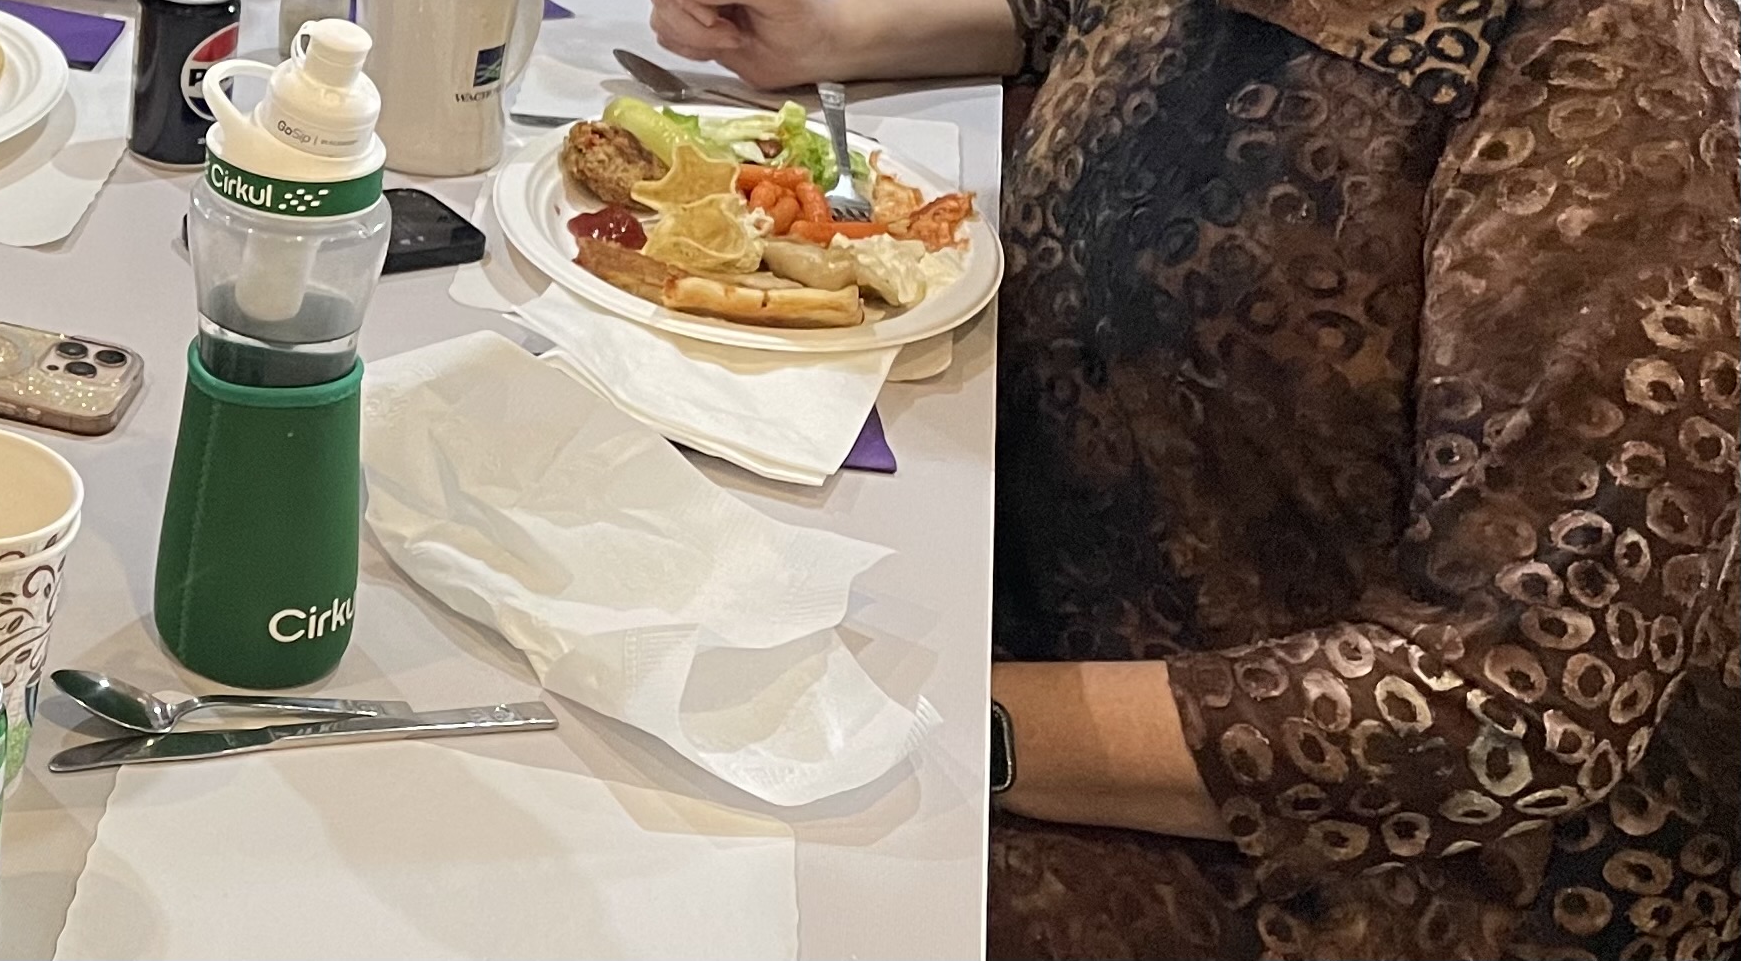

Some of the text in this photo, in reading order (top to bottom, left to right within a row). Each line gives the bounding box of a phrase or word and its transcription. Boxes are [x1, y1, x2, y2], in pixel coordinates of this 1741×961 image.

[277, 120, 312, 144] GoSip
[210, 163, 274, 208] Cirkul
[268, 597, 355, 643] Cirku
